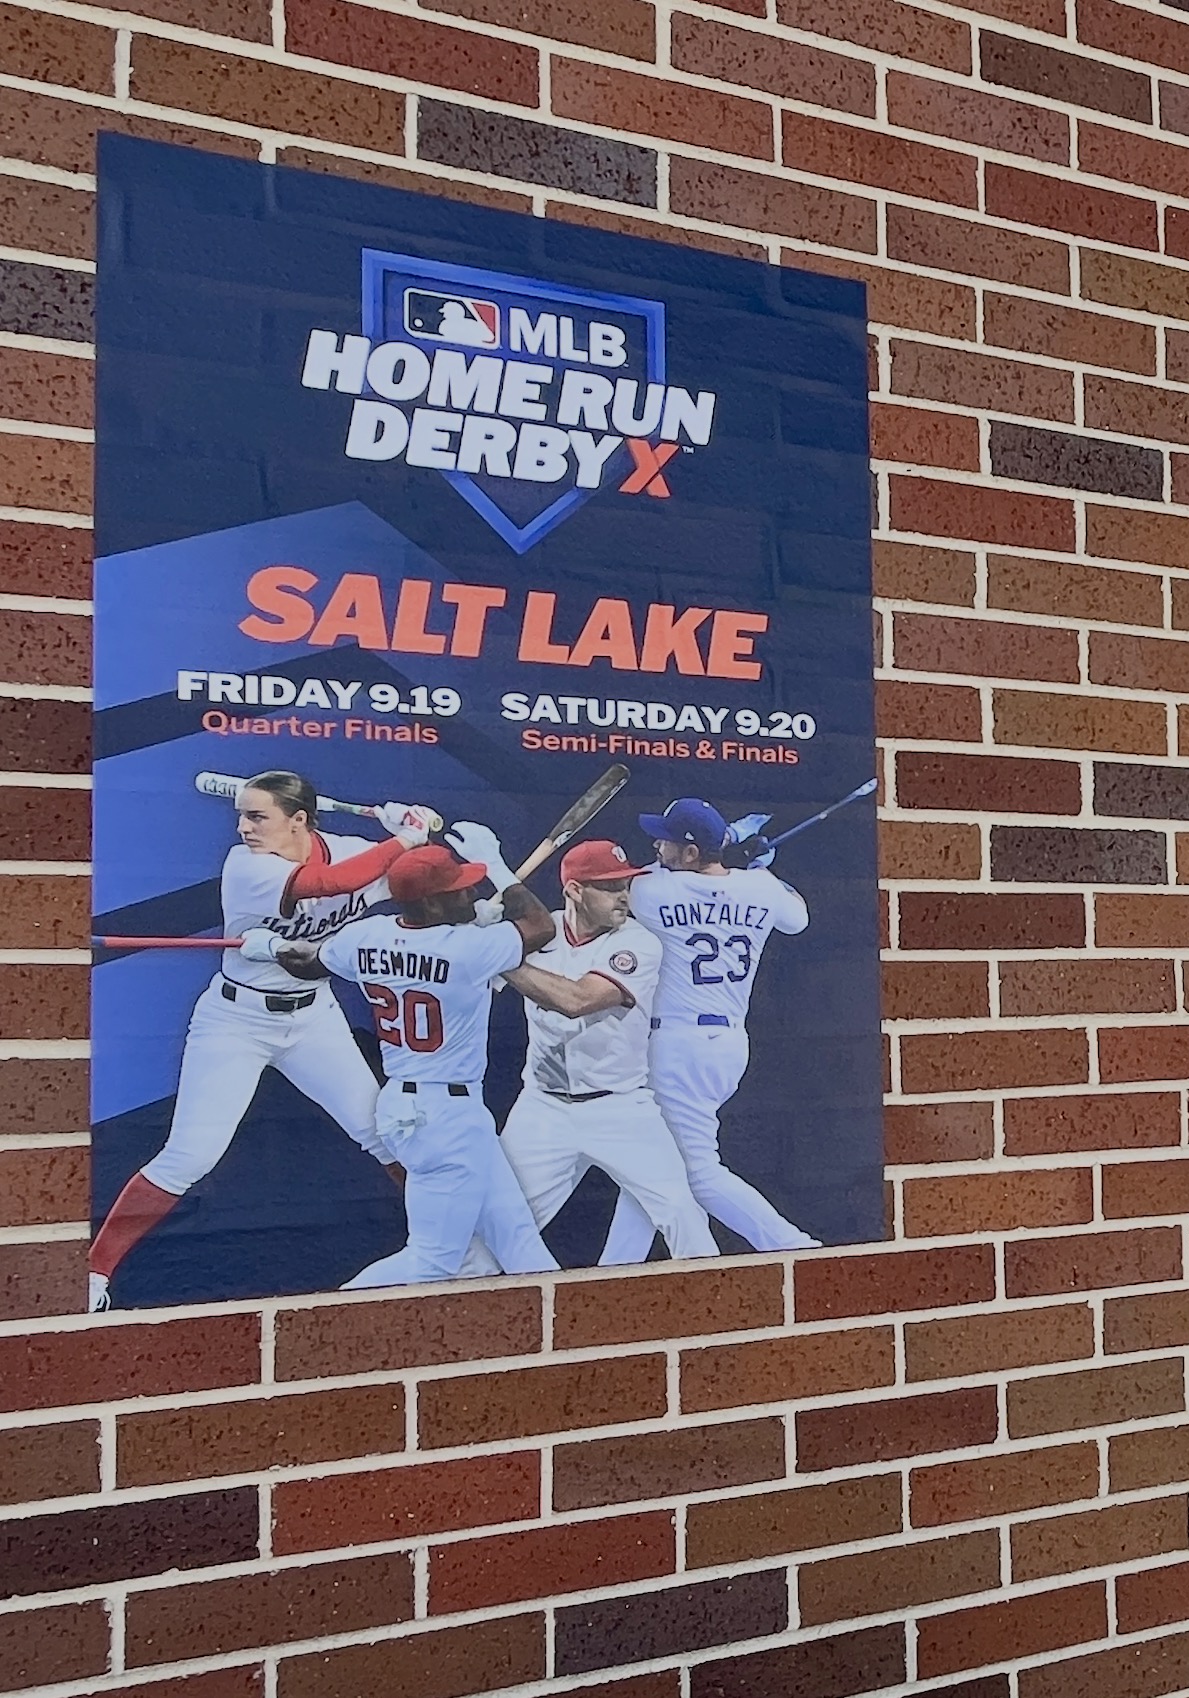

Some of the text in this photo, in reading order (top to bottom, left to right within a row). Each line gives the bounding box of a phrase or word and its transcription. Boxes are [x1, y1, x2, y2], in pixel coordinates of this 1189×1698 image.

[508, 306, 628, 368] MLB
[301, 329, 716, 446] HOME RUN
[344, 399, 623, 489] DERBY
[237, 565, 769, 680] SALT LAKE
[177, 670, 462, 717] FRIDAY 9.19
[500, 691, 817, 740] SATURDAY 9.20
[201, 710, 440, 744] Quarter Finals
[521, 728, 800, 765] Semi-Finals & Finals
[658, 902, 770, 931] GONZALEZ
[357, 948, 450, 984] DESMOND
[684, 932, 753, 986] 23
[364, 982, 445, 1053] 20
